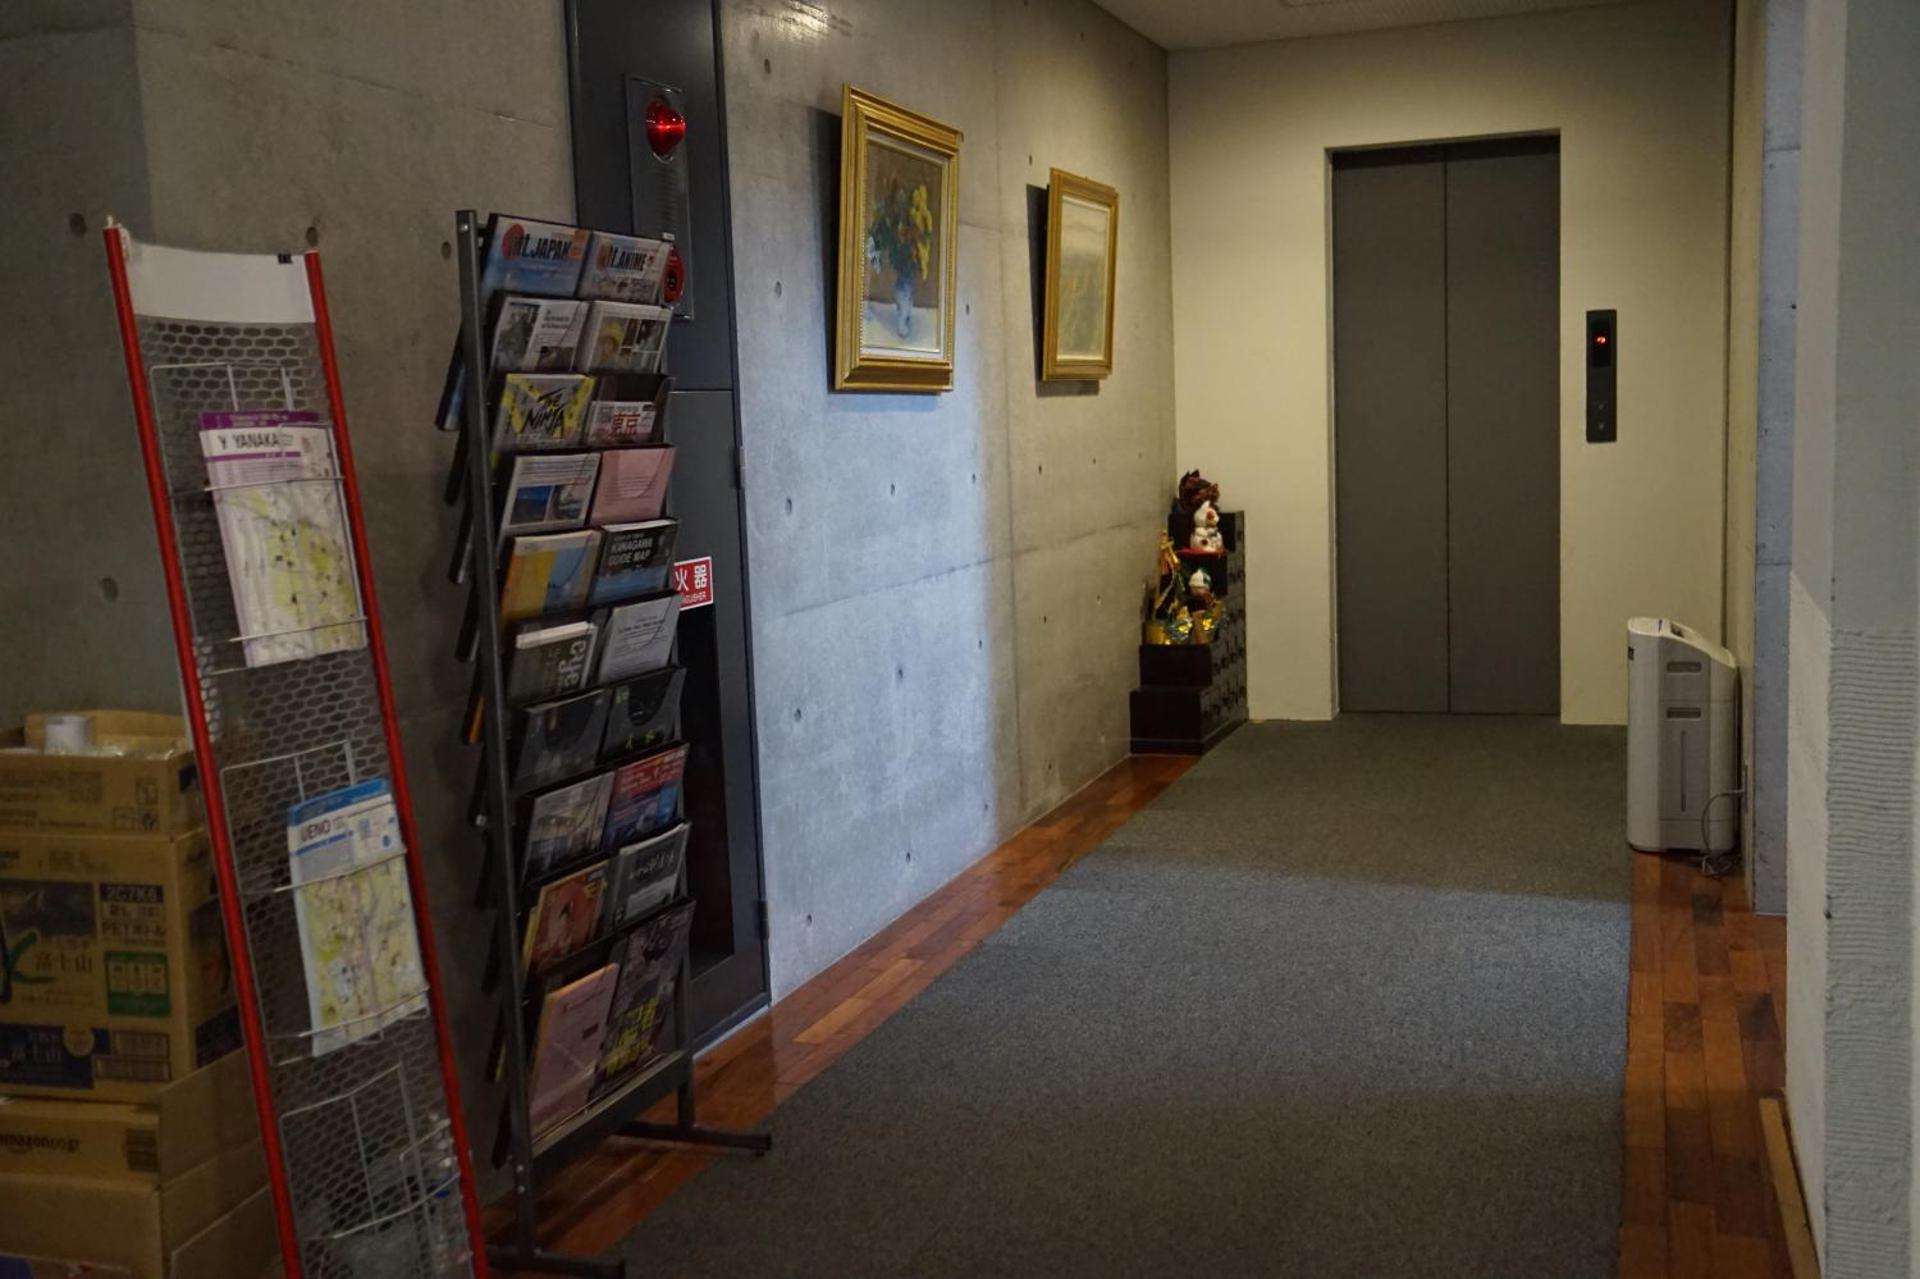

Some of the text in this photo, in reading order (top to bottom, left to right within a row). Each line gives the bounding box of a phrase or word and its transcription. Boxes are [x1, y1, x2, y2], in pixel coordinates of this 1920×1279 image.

[611, 412, 640, 435] 東京
[232, 431, 280, 449] YANAKA
[300, 819, 331, 842] UENO
